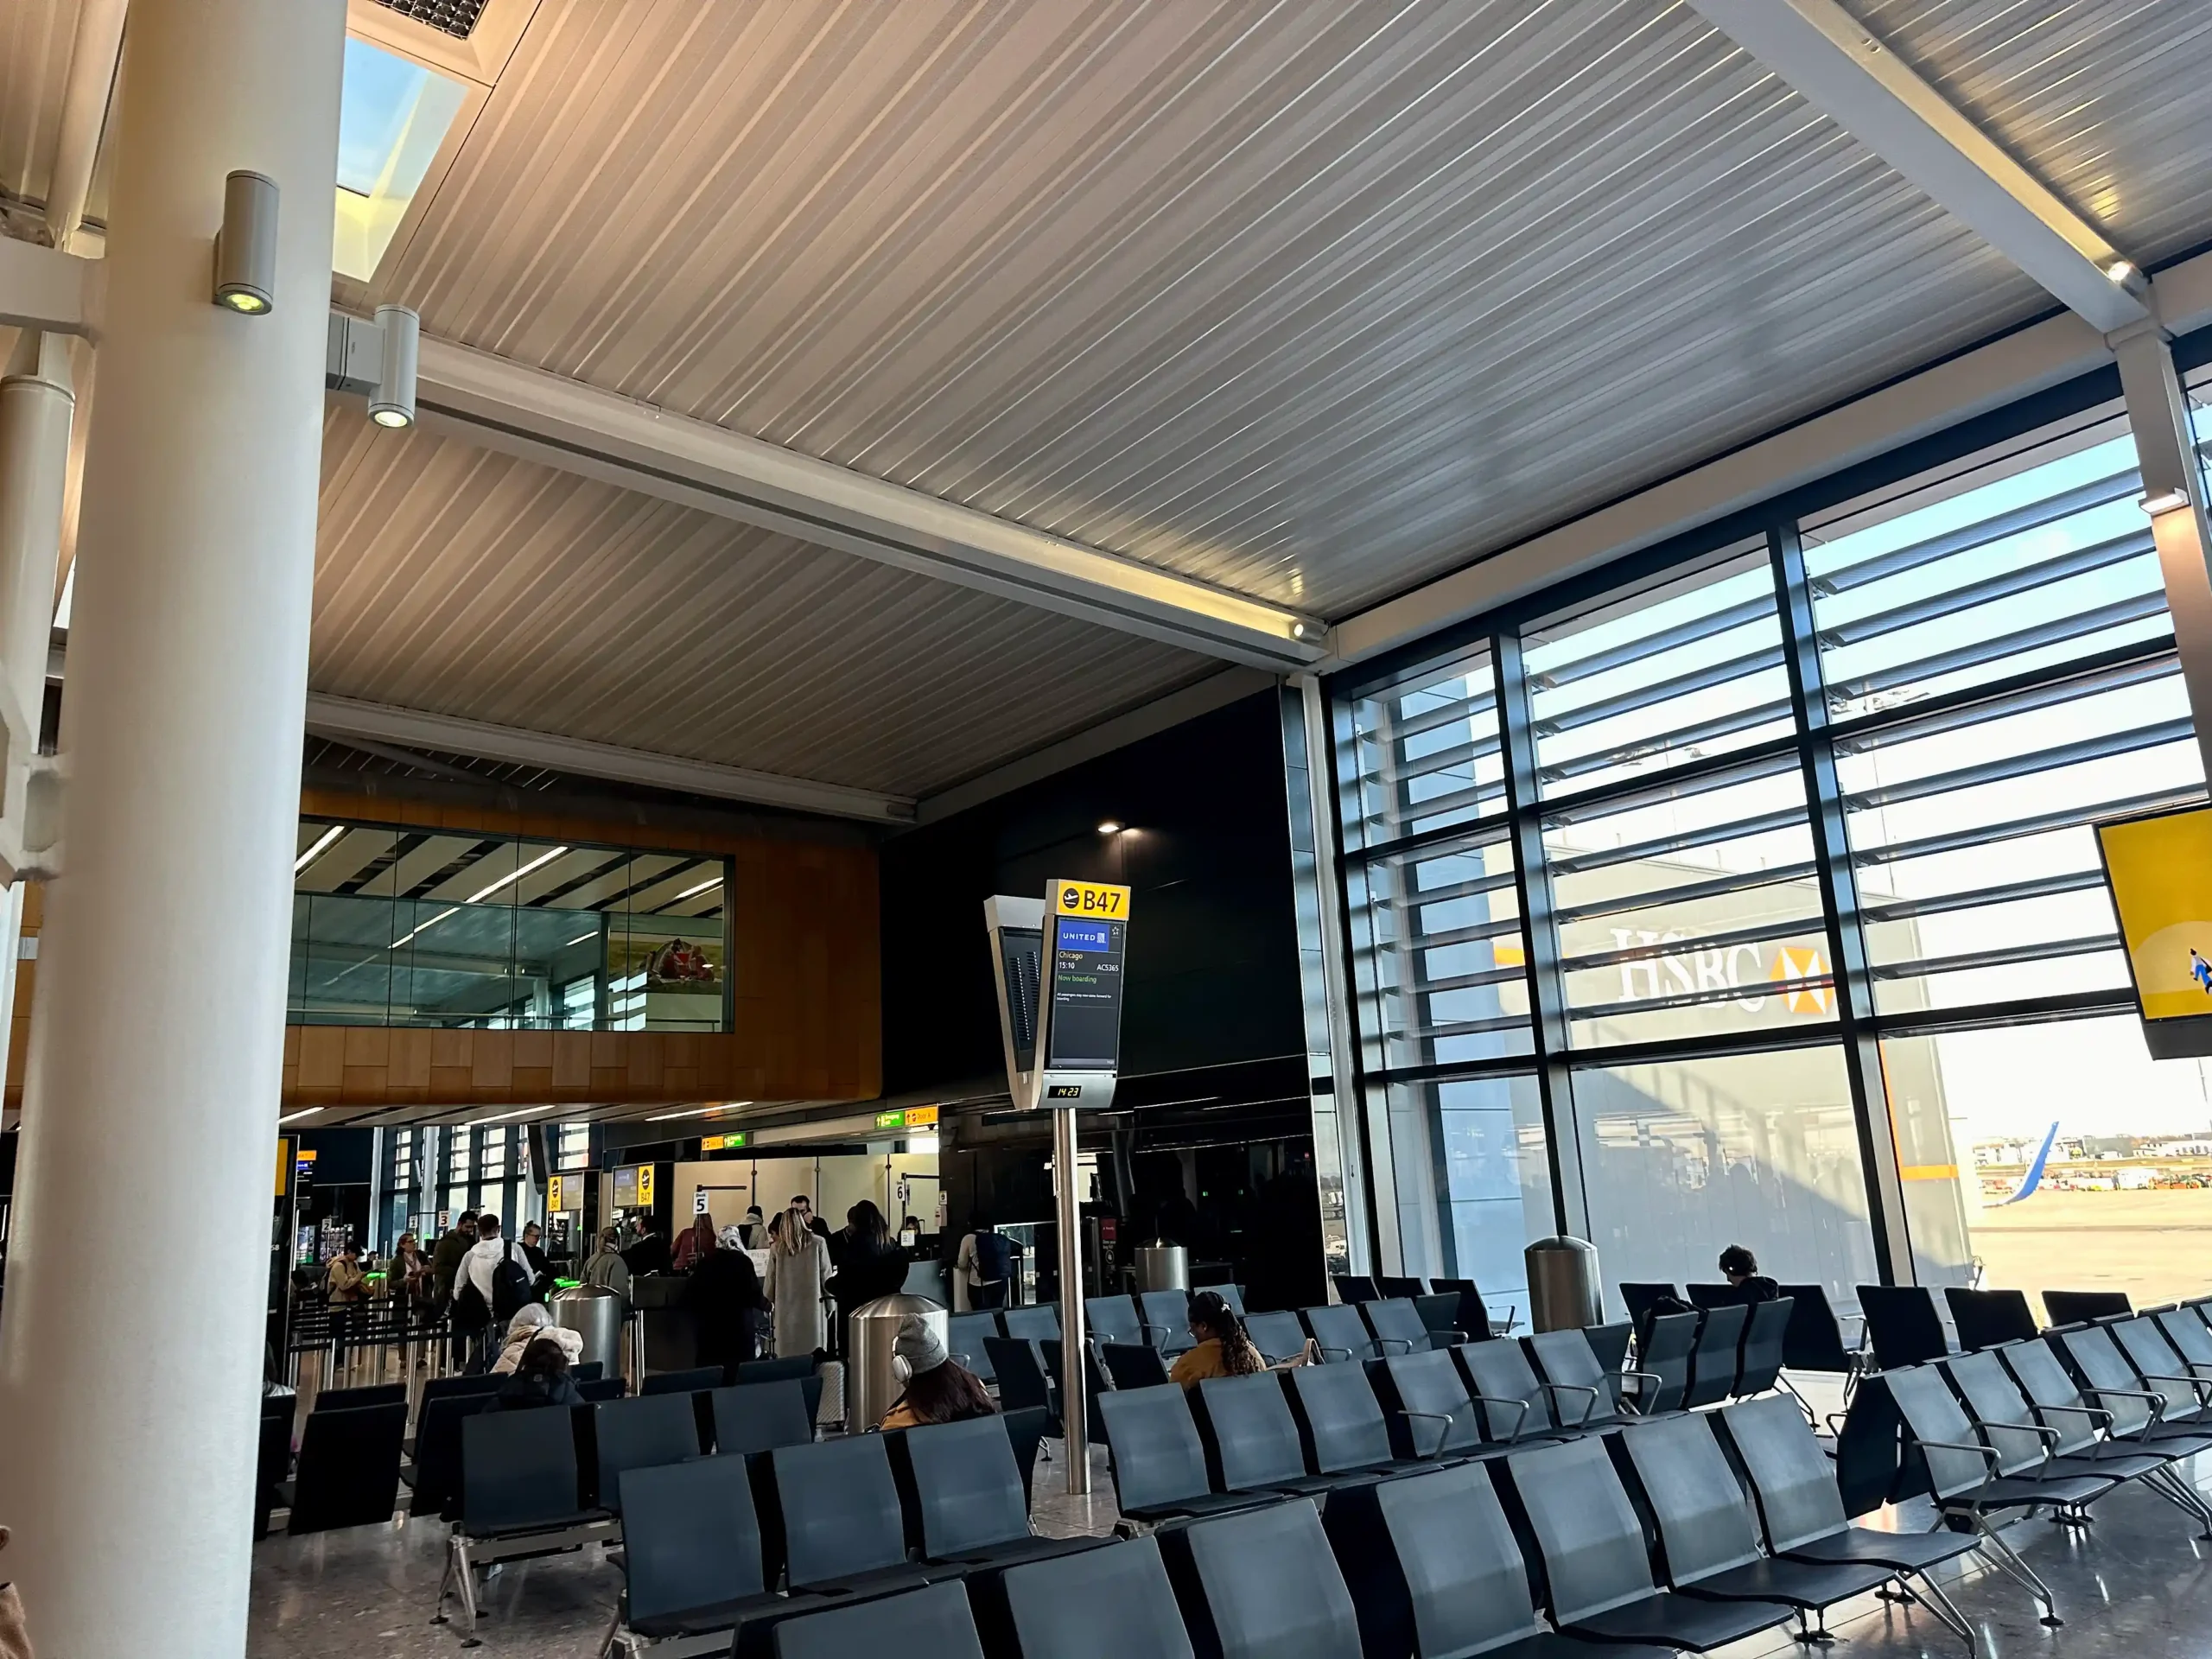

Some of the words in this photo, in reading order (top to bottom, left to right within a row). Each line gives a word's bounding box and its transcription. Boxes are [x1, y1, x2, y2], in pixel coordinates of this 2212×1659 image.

[1084, 890, 1121, 912] B47
[1063, 932, 1096, 941] UNITED
[1059, 951, 1083, 961] Chicago
[1096, 963, 1119, 972] AC5365
[1611, 928, 1766, 1012] HSBC
[1072, 975, 1096, 984] boarding
[640, 1192, 651, 1203] B47
[898, 1186, 903, 1199] 6
[696, 1199, 705, 1211] 5
[441, 1216, 448, 1225] 3
